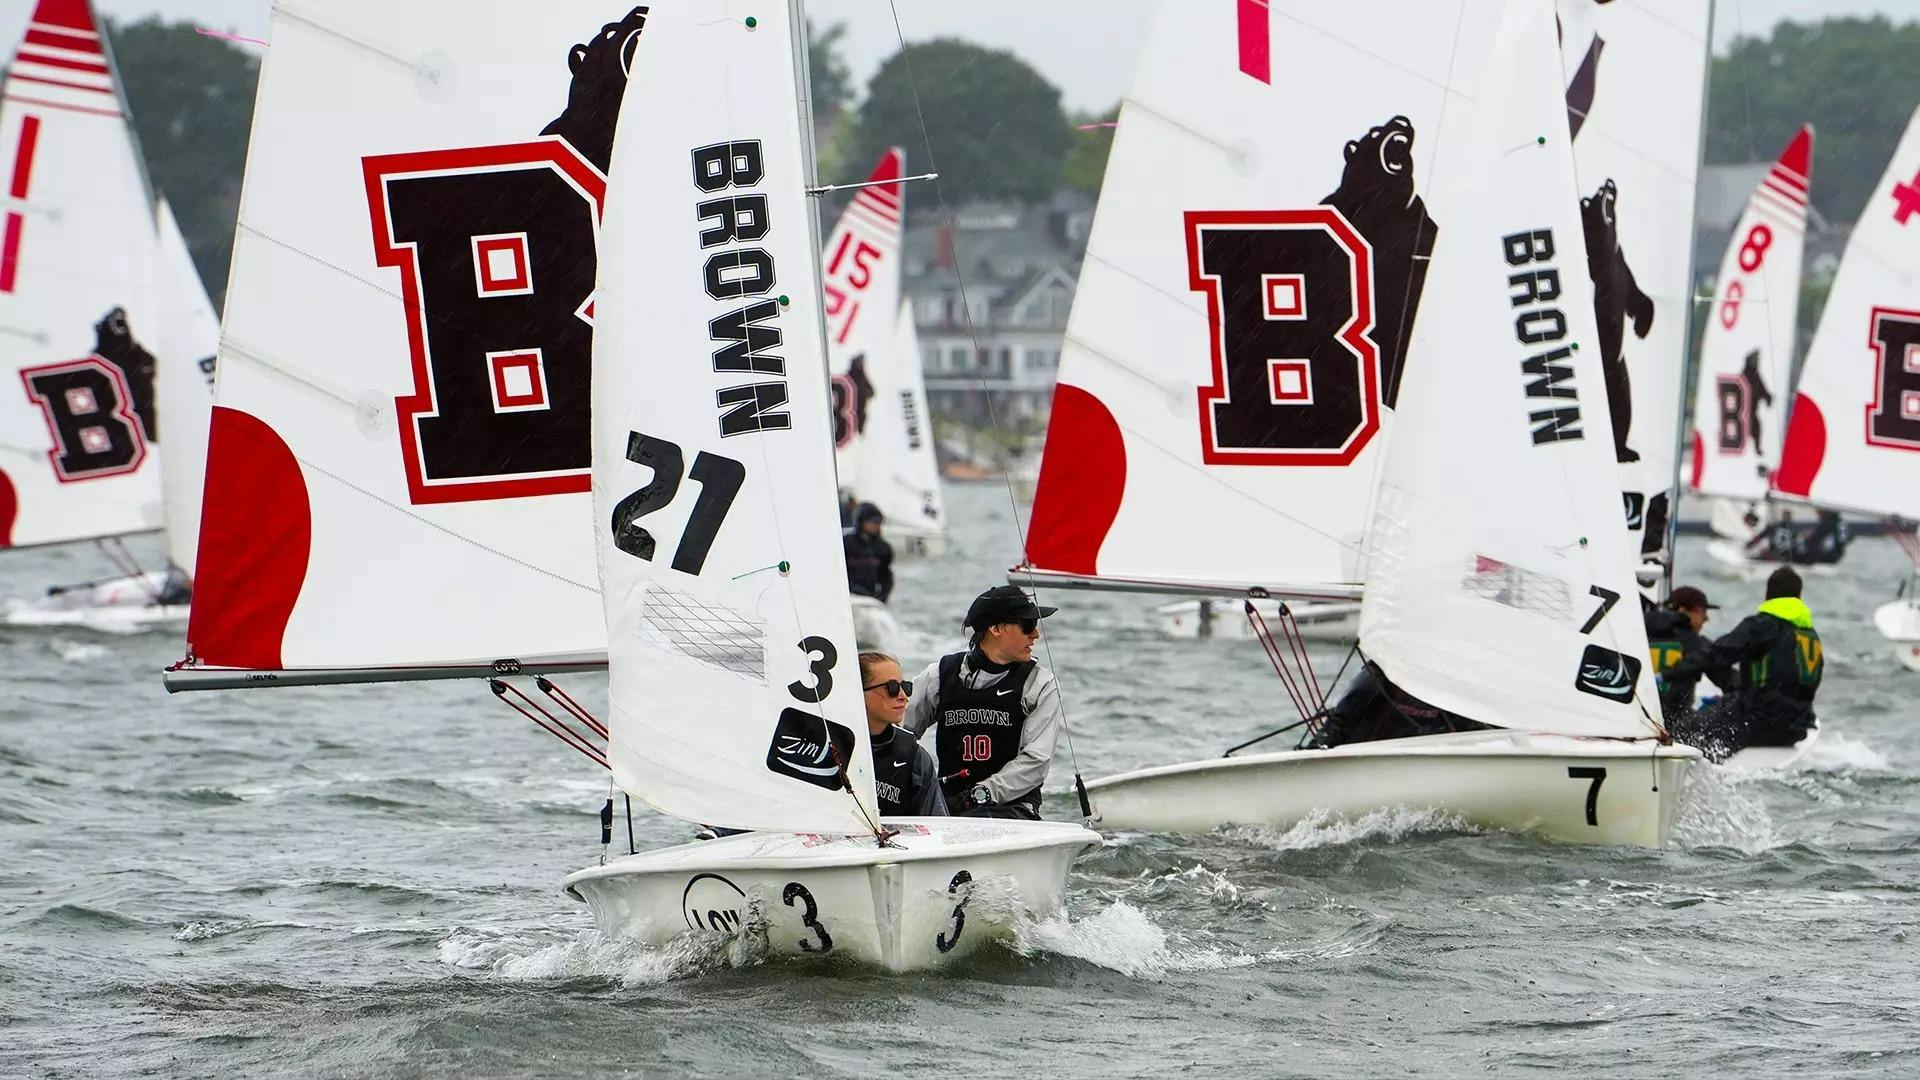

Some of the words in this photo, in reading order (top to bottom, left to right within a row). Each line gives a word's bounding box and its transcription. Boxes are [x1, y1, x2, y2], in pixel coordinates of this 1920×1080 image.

[829, 232, 880, 290] 15
[1738, 224, 1772, 273] 8
[691, 139, 792, 439] BROWN
[1184, 204, 1380, 467] B
[1501, 227, 1585, 448] BROWN
[20, 353, 149, 484] B
[1717, 374, 1750, 453] B
[1579, 584, 1620, 635] 7
[788, 635, 838, 703] 3
[777, 735, 819, 758] Zim
[962, 734, 992, 762] 10
[1568, 766, 1607, 826] 7
[783, 882, 833, 951] 3
